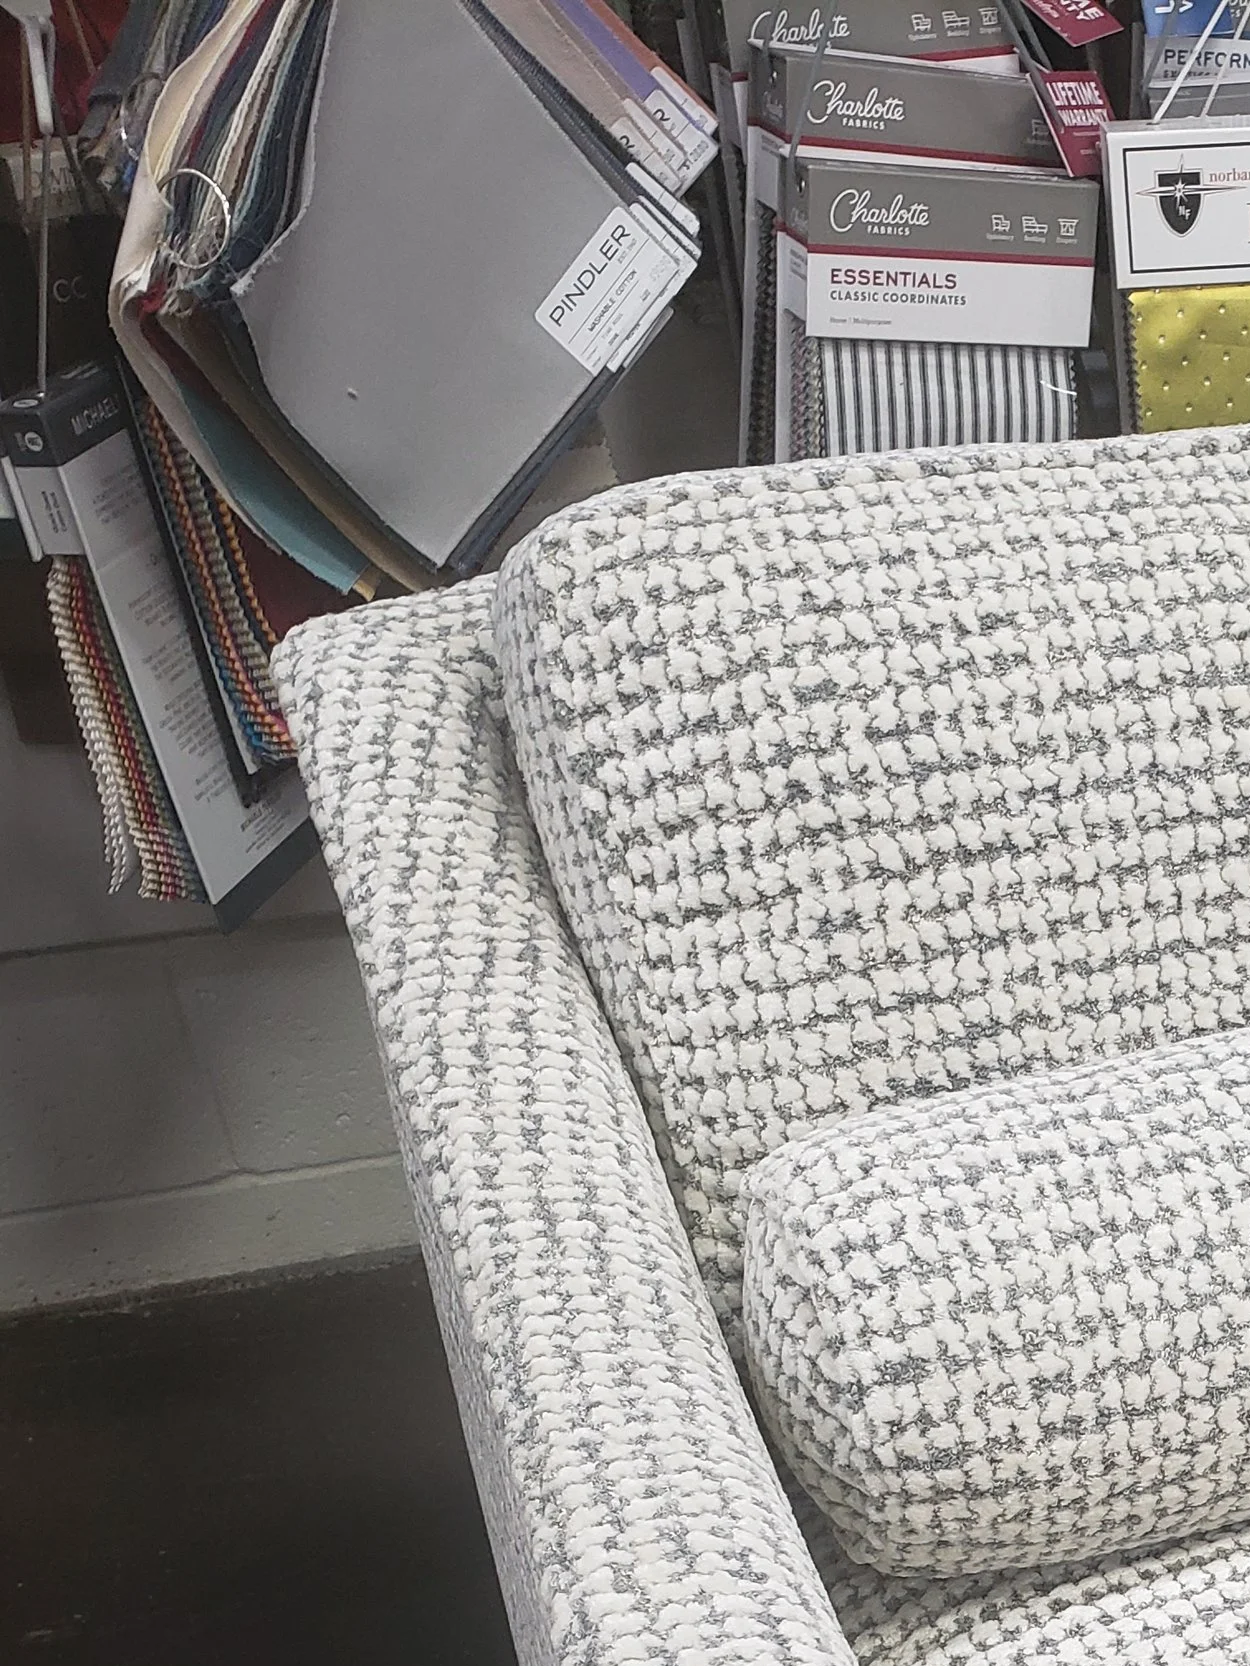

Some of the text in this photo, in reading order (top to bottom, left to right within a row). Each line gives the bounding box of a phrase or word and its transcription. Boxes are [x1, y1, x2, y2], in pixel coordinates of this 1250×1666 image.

[751, 9, 850, 44] Charlote
[807, 79, 905, 124] Charlotte
[1047, 81, 1104, 106] LIFETIME
[842, 117, 885, 130] FABRICS
[1058, 108, 1110, 126] WARRANTY
[829, 188, 930, 234] Charlotte
[866, 225, 911, 236] FABRICS
[549, 224, 631, 328] PINDLER
[615, 269, 638, 296] COTTON
[830, 268, 957, 290] ESSENTIALS
[829, 290, 967, 306] CLASSIC COORDINATES
